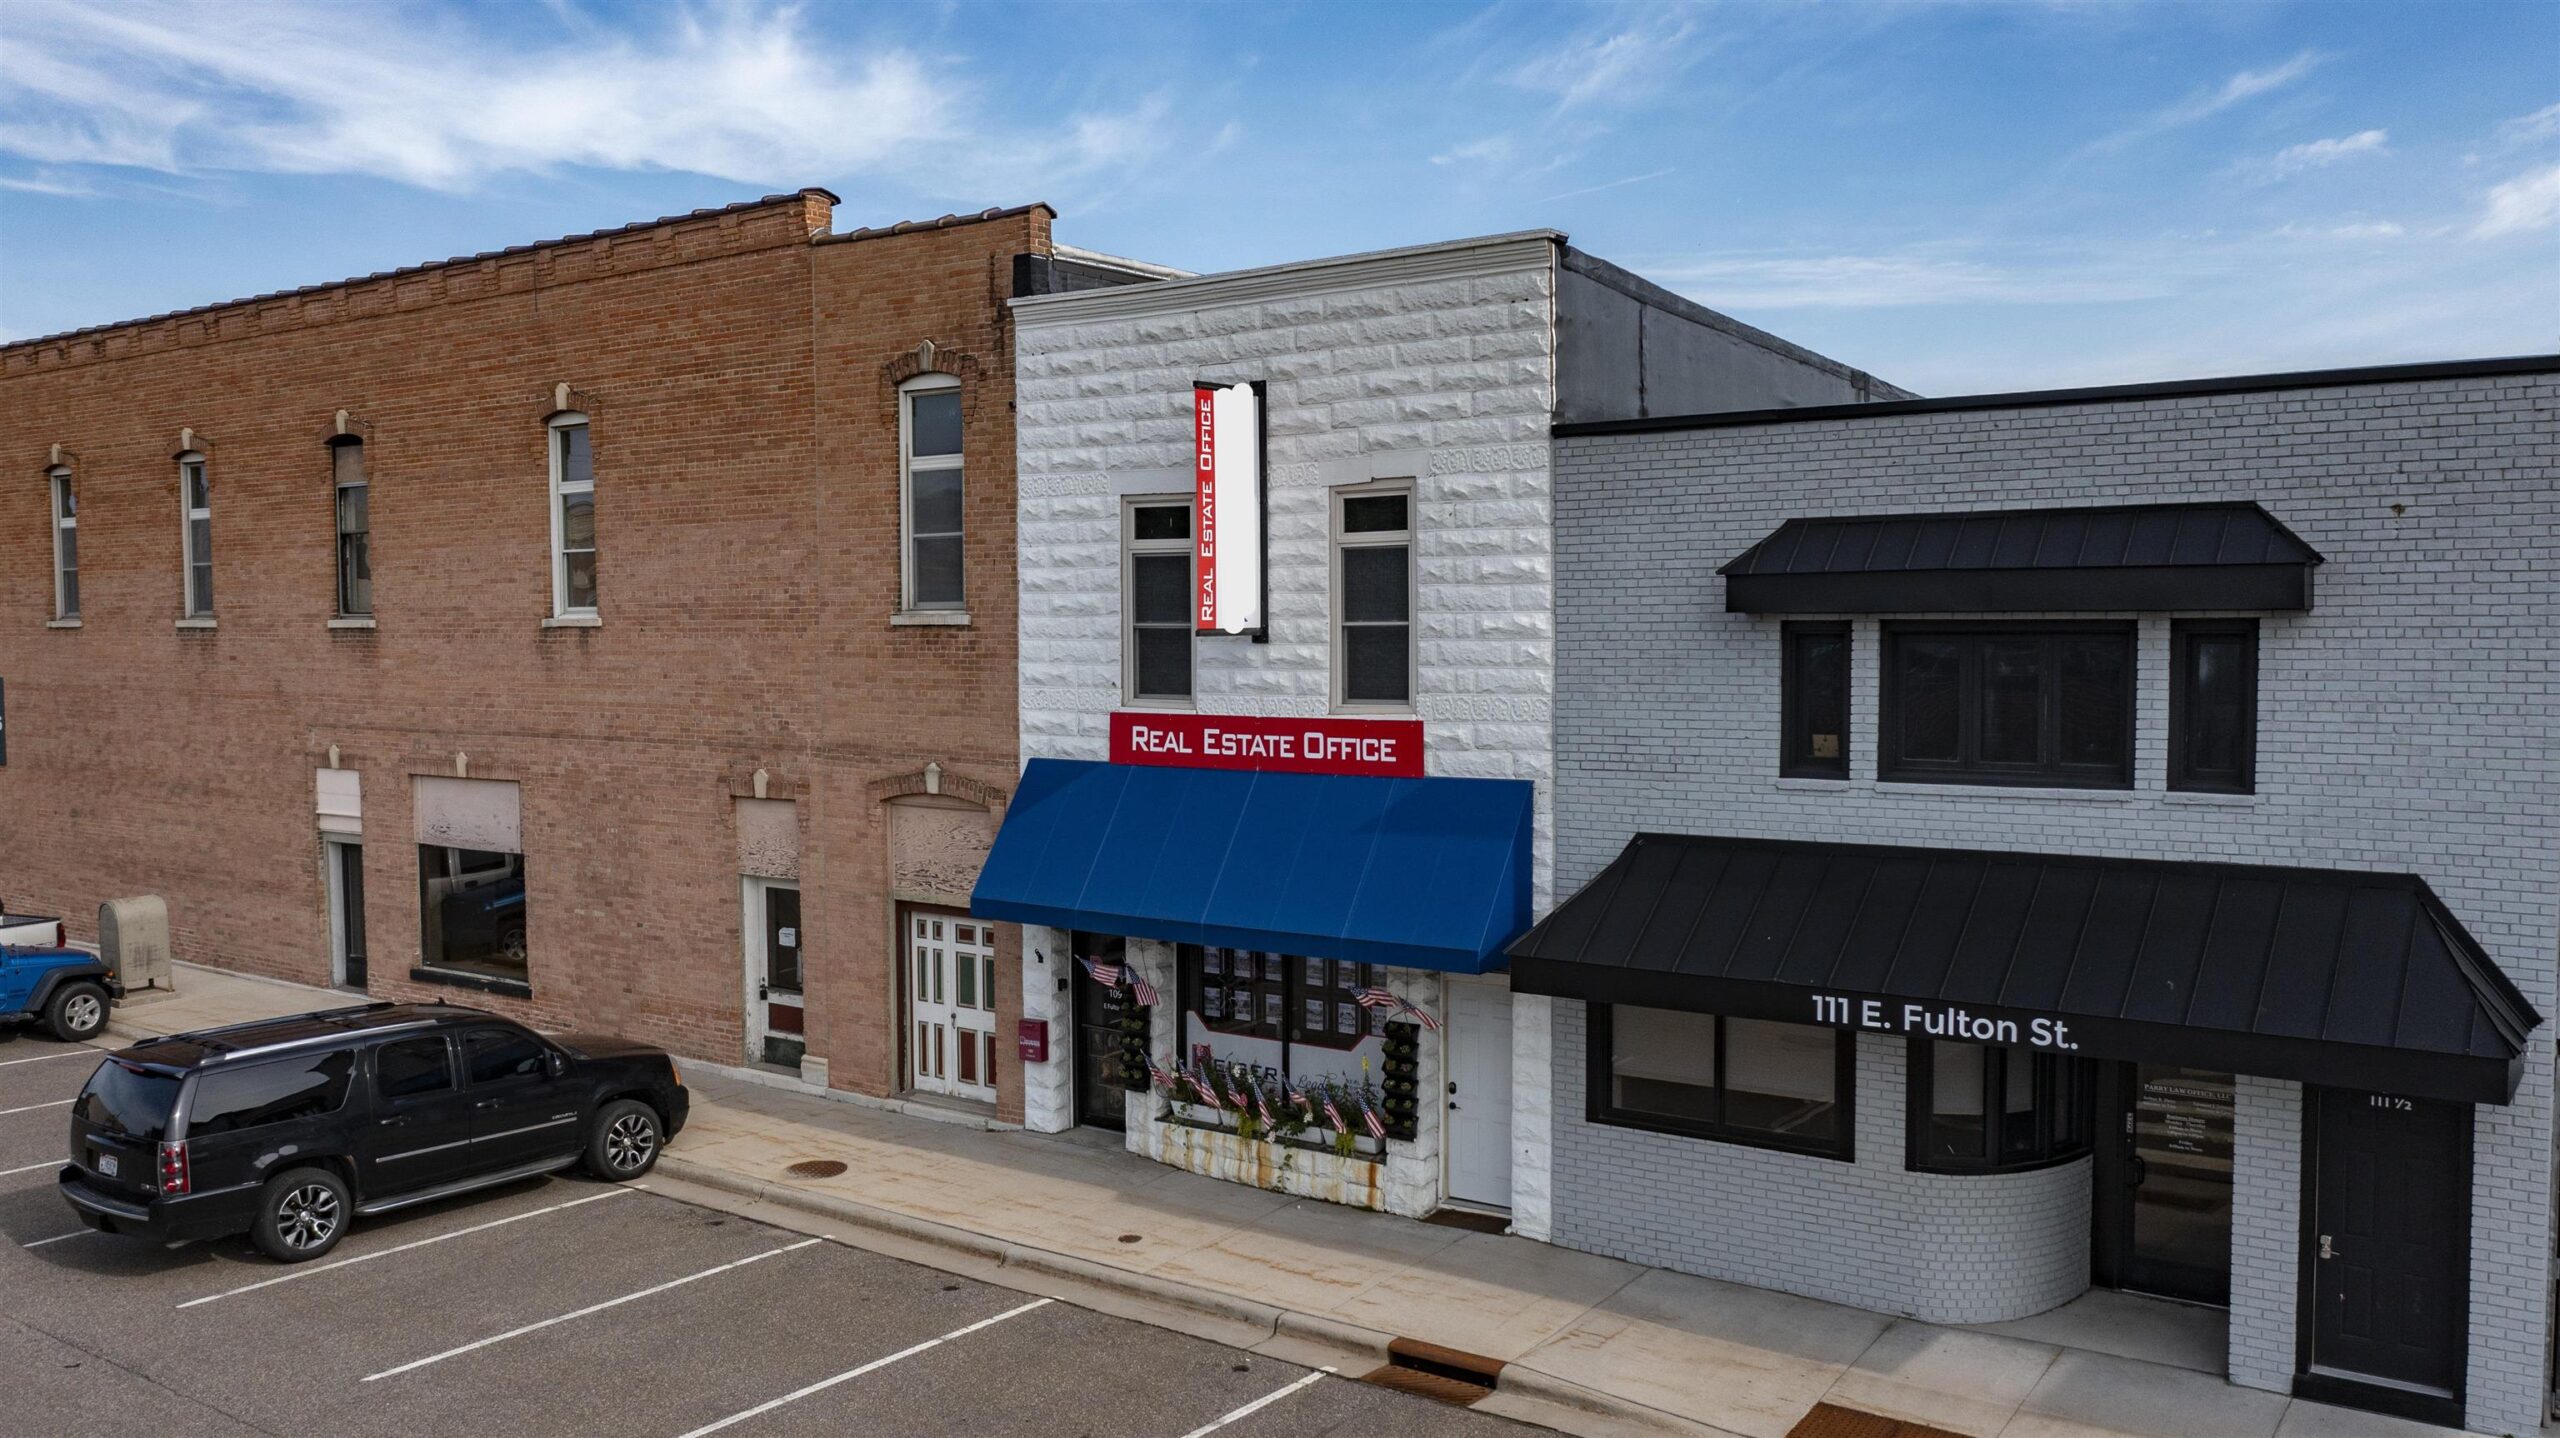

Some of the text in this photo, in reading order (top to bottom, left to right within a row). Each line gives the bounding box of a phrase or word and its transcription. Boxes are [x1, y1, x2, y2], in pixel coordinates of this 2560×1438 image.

[1812, 995, 2079, 1050] 111 E. Fulton St.
